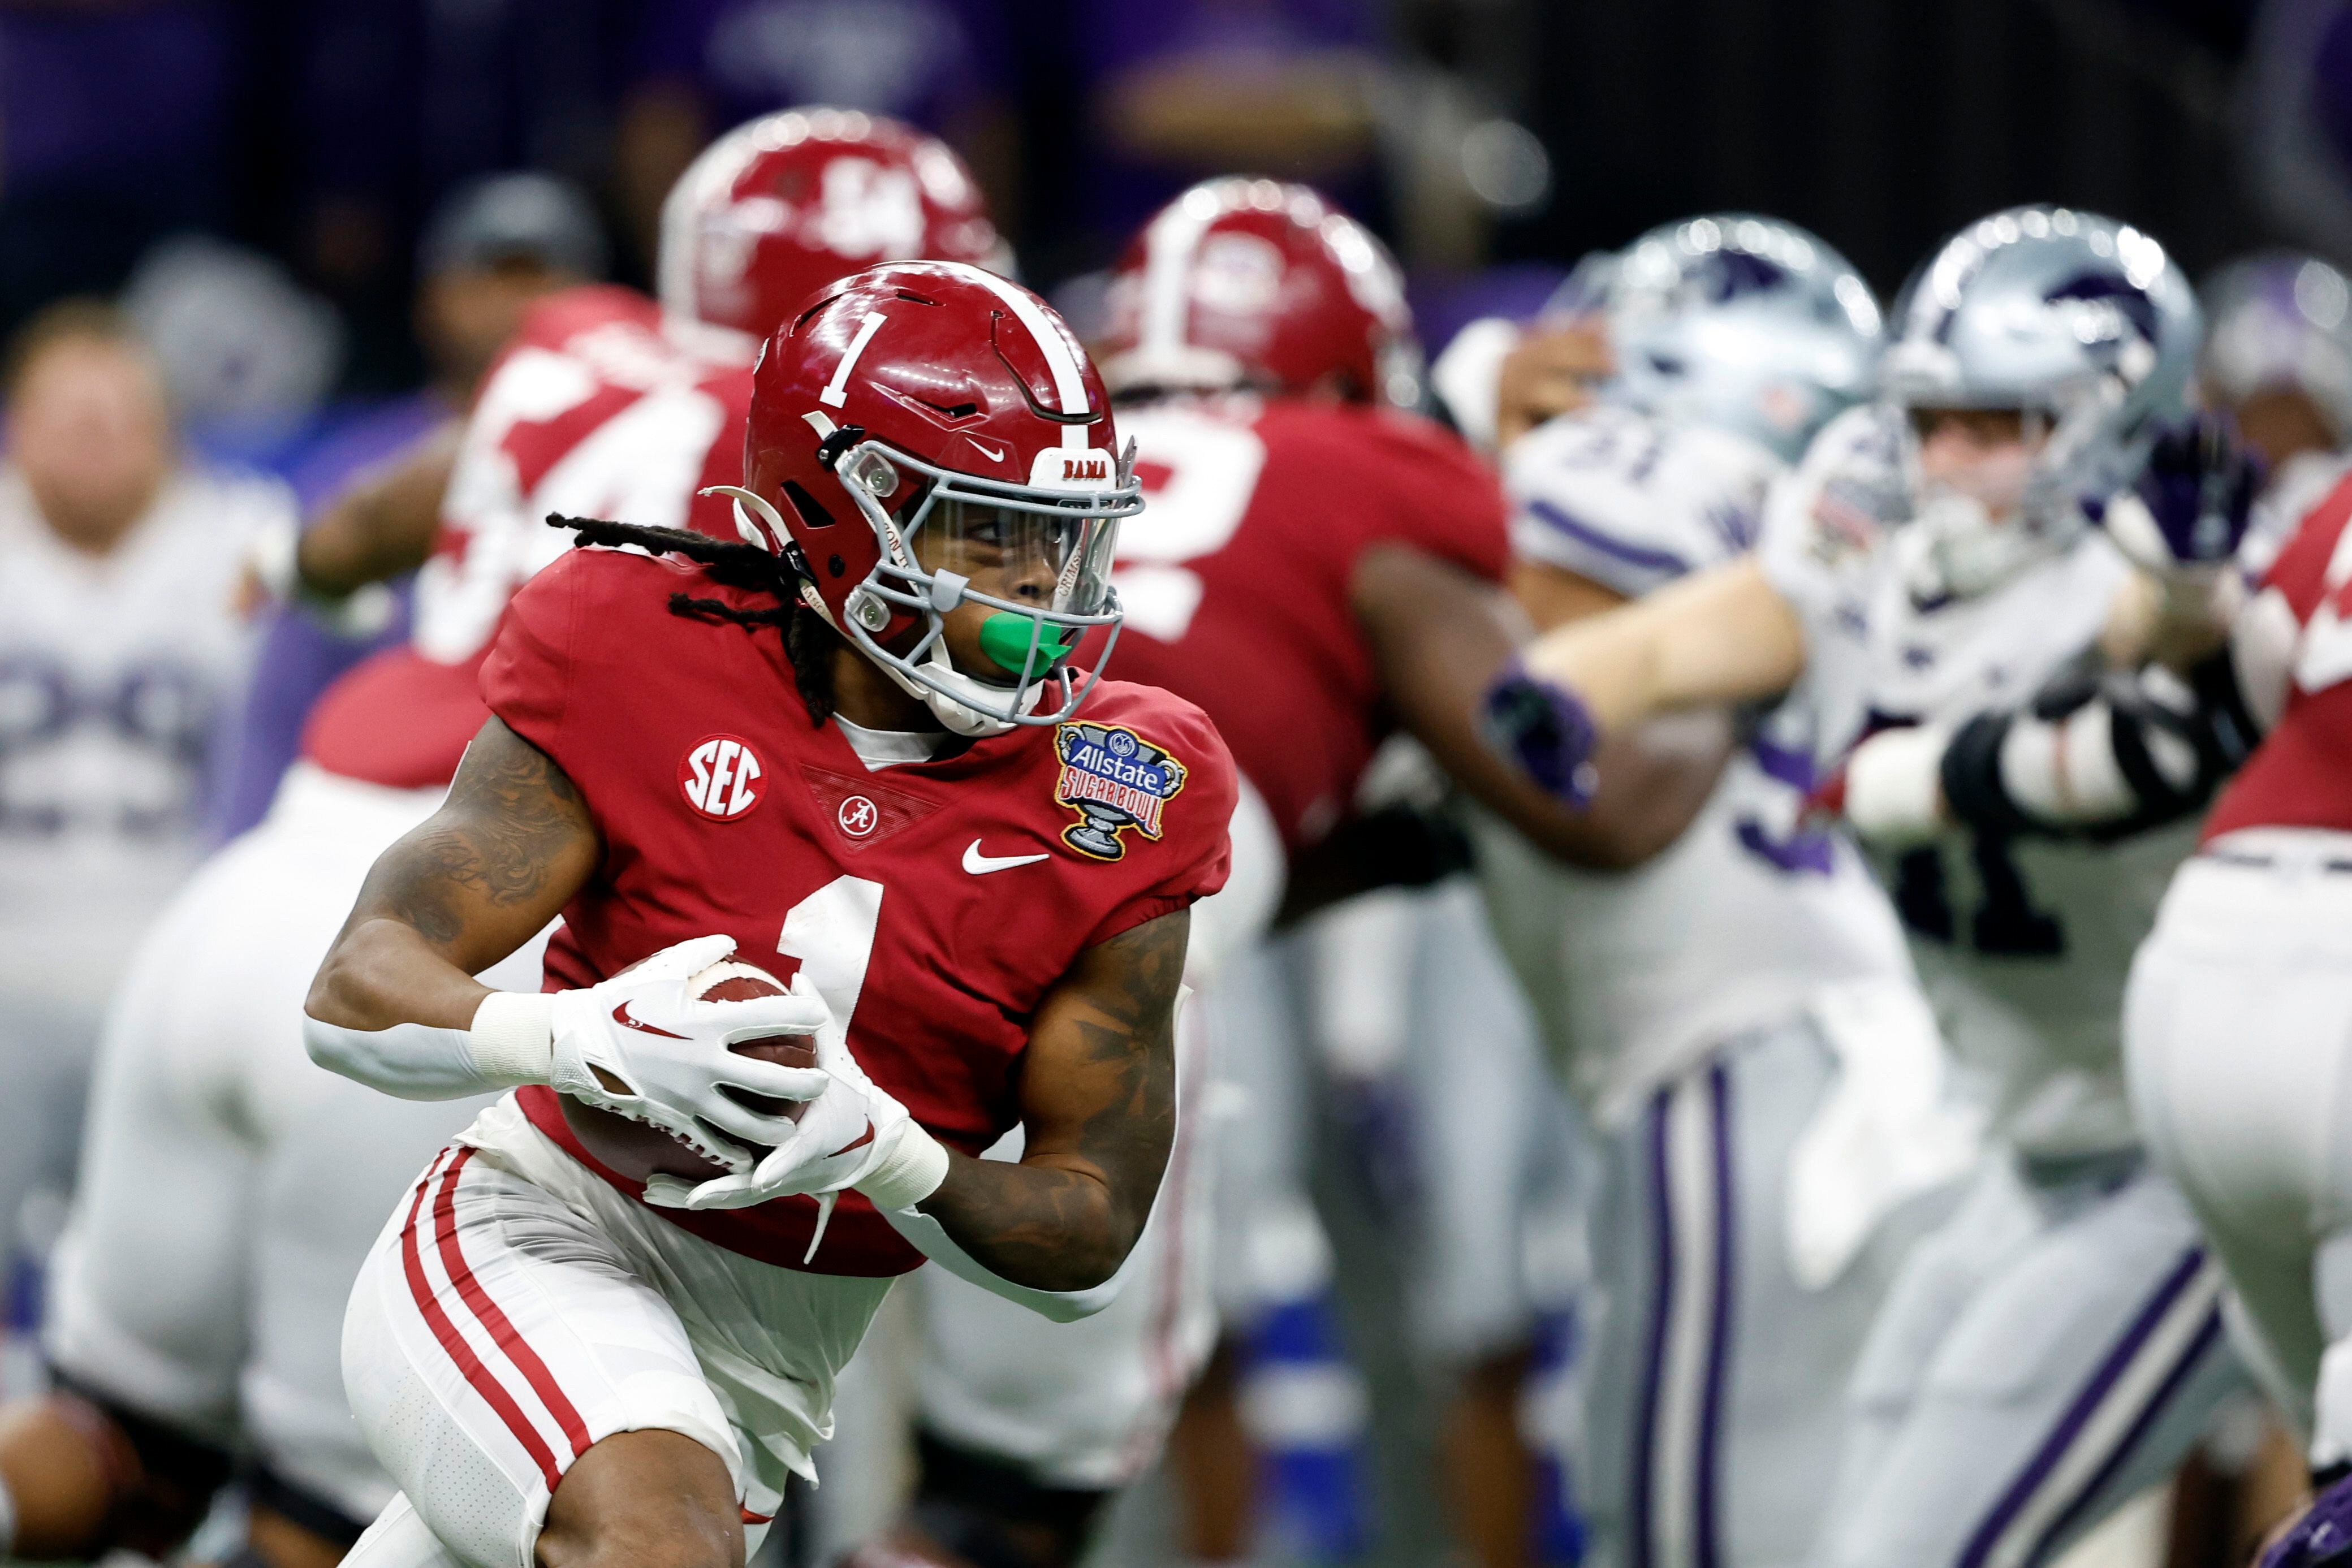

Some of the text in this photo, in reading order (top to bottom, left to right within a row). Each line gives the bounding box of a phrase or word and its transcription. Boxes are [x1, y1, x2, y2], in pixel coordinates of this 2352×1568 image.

[819, 312, 888, 408] 1
[1063, 460, 1106, 478] BAMA
[684, 739, 761, 816] SEC
[1071, 745, 1159, 791] Allstate
[843, 802, 870, 828] A
[776, 875, 883, 1044] 1
